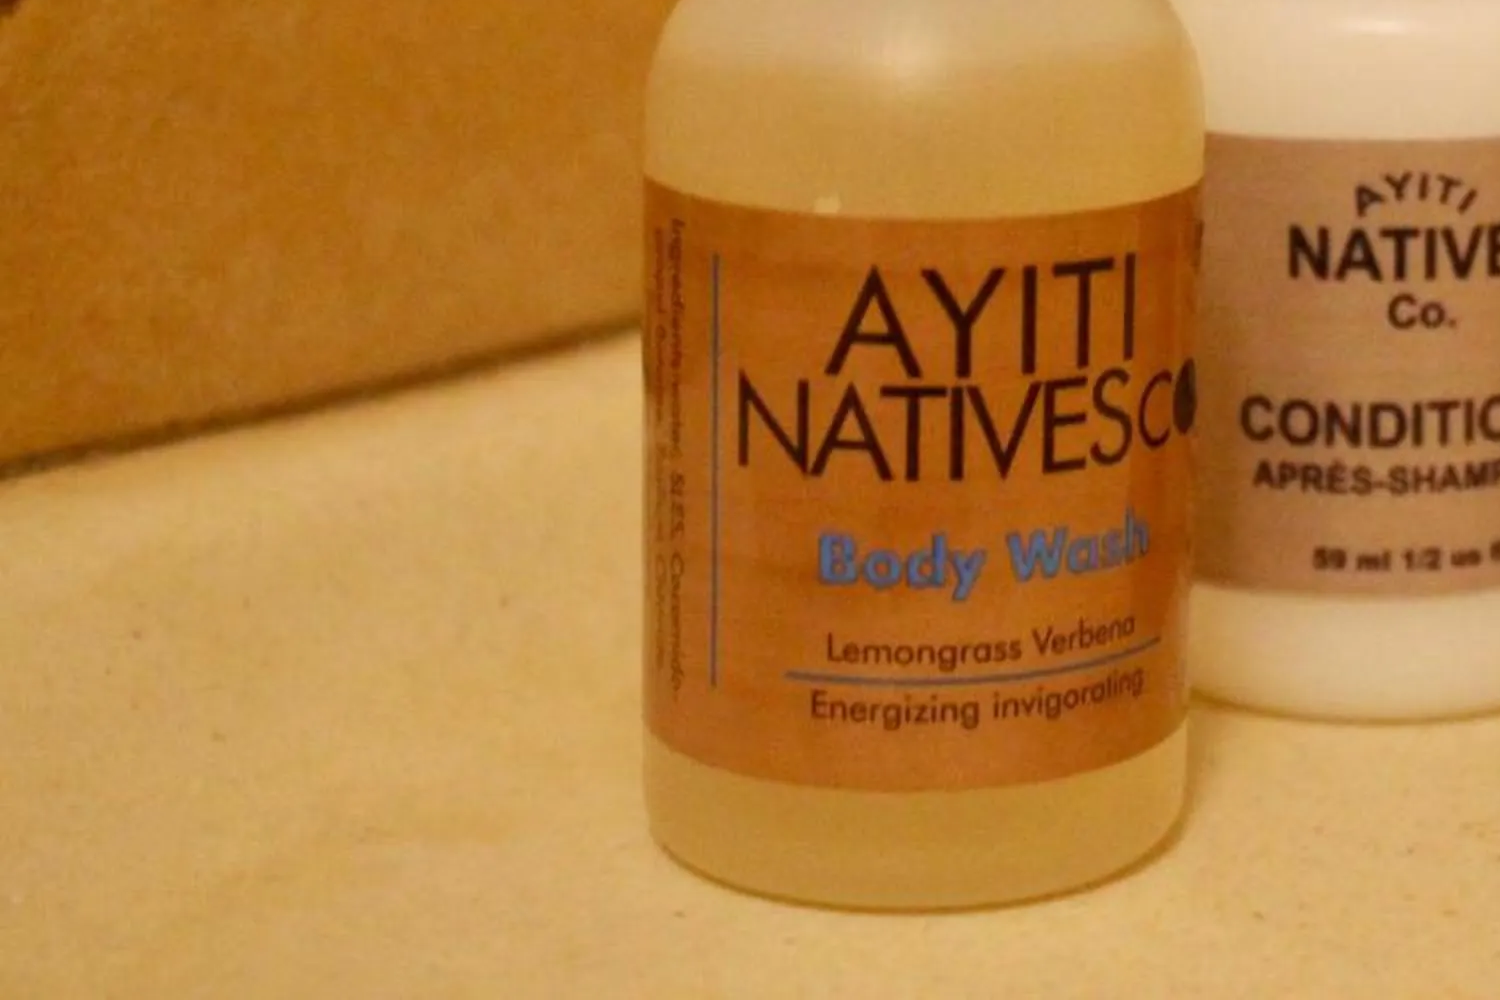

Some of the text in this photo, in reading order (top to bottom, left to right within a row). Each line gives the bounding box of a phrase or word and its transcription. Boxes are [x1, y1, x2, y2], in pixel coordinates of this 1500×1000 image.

[1352, 171, 1477, 217] AYITI
[824, 252, 1136, 379] AYITI
[1387, 293, 1457, 330] Co.
[816, 505, 1149, 603] Body Wash
[827, 615, 1136, 672] Lemongrass Verbena
[811, 669, 1144, 730] Energizing invigorating
